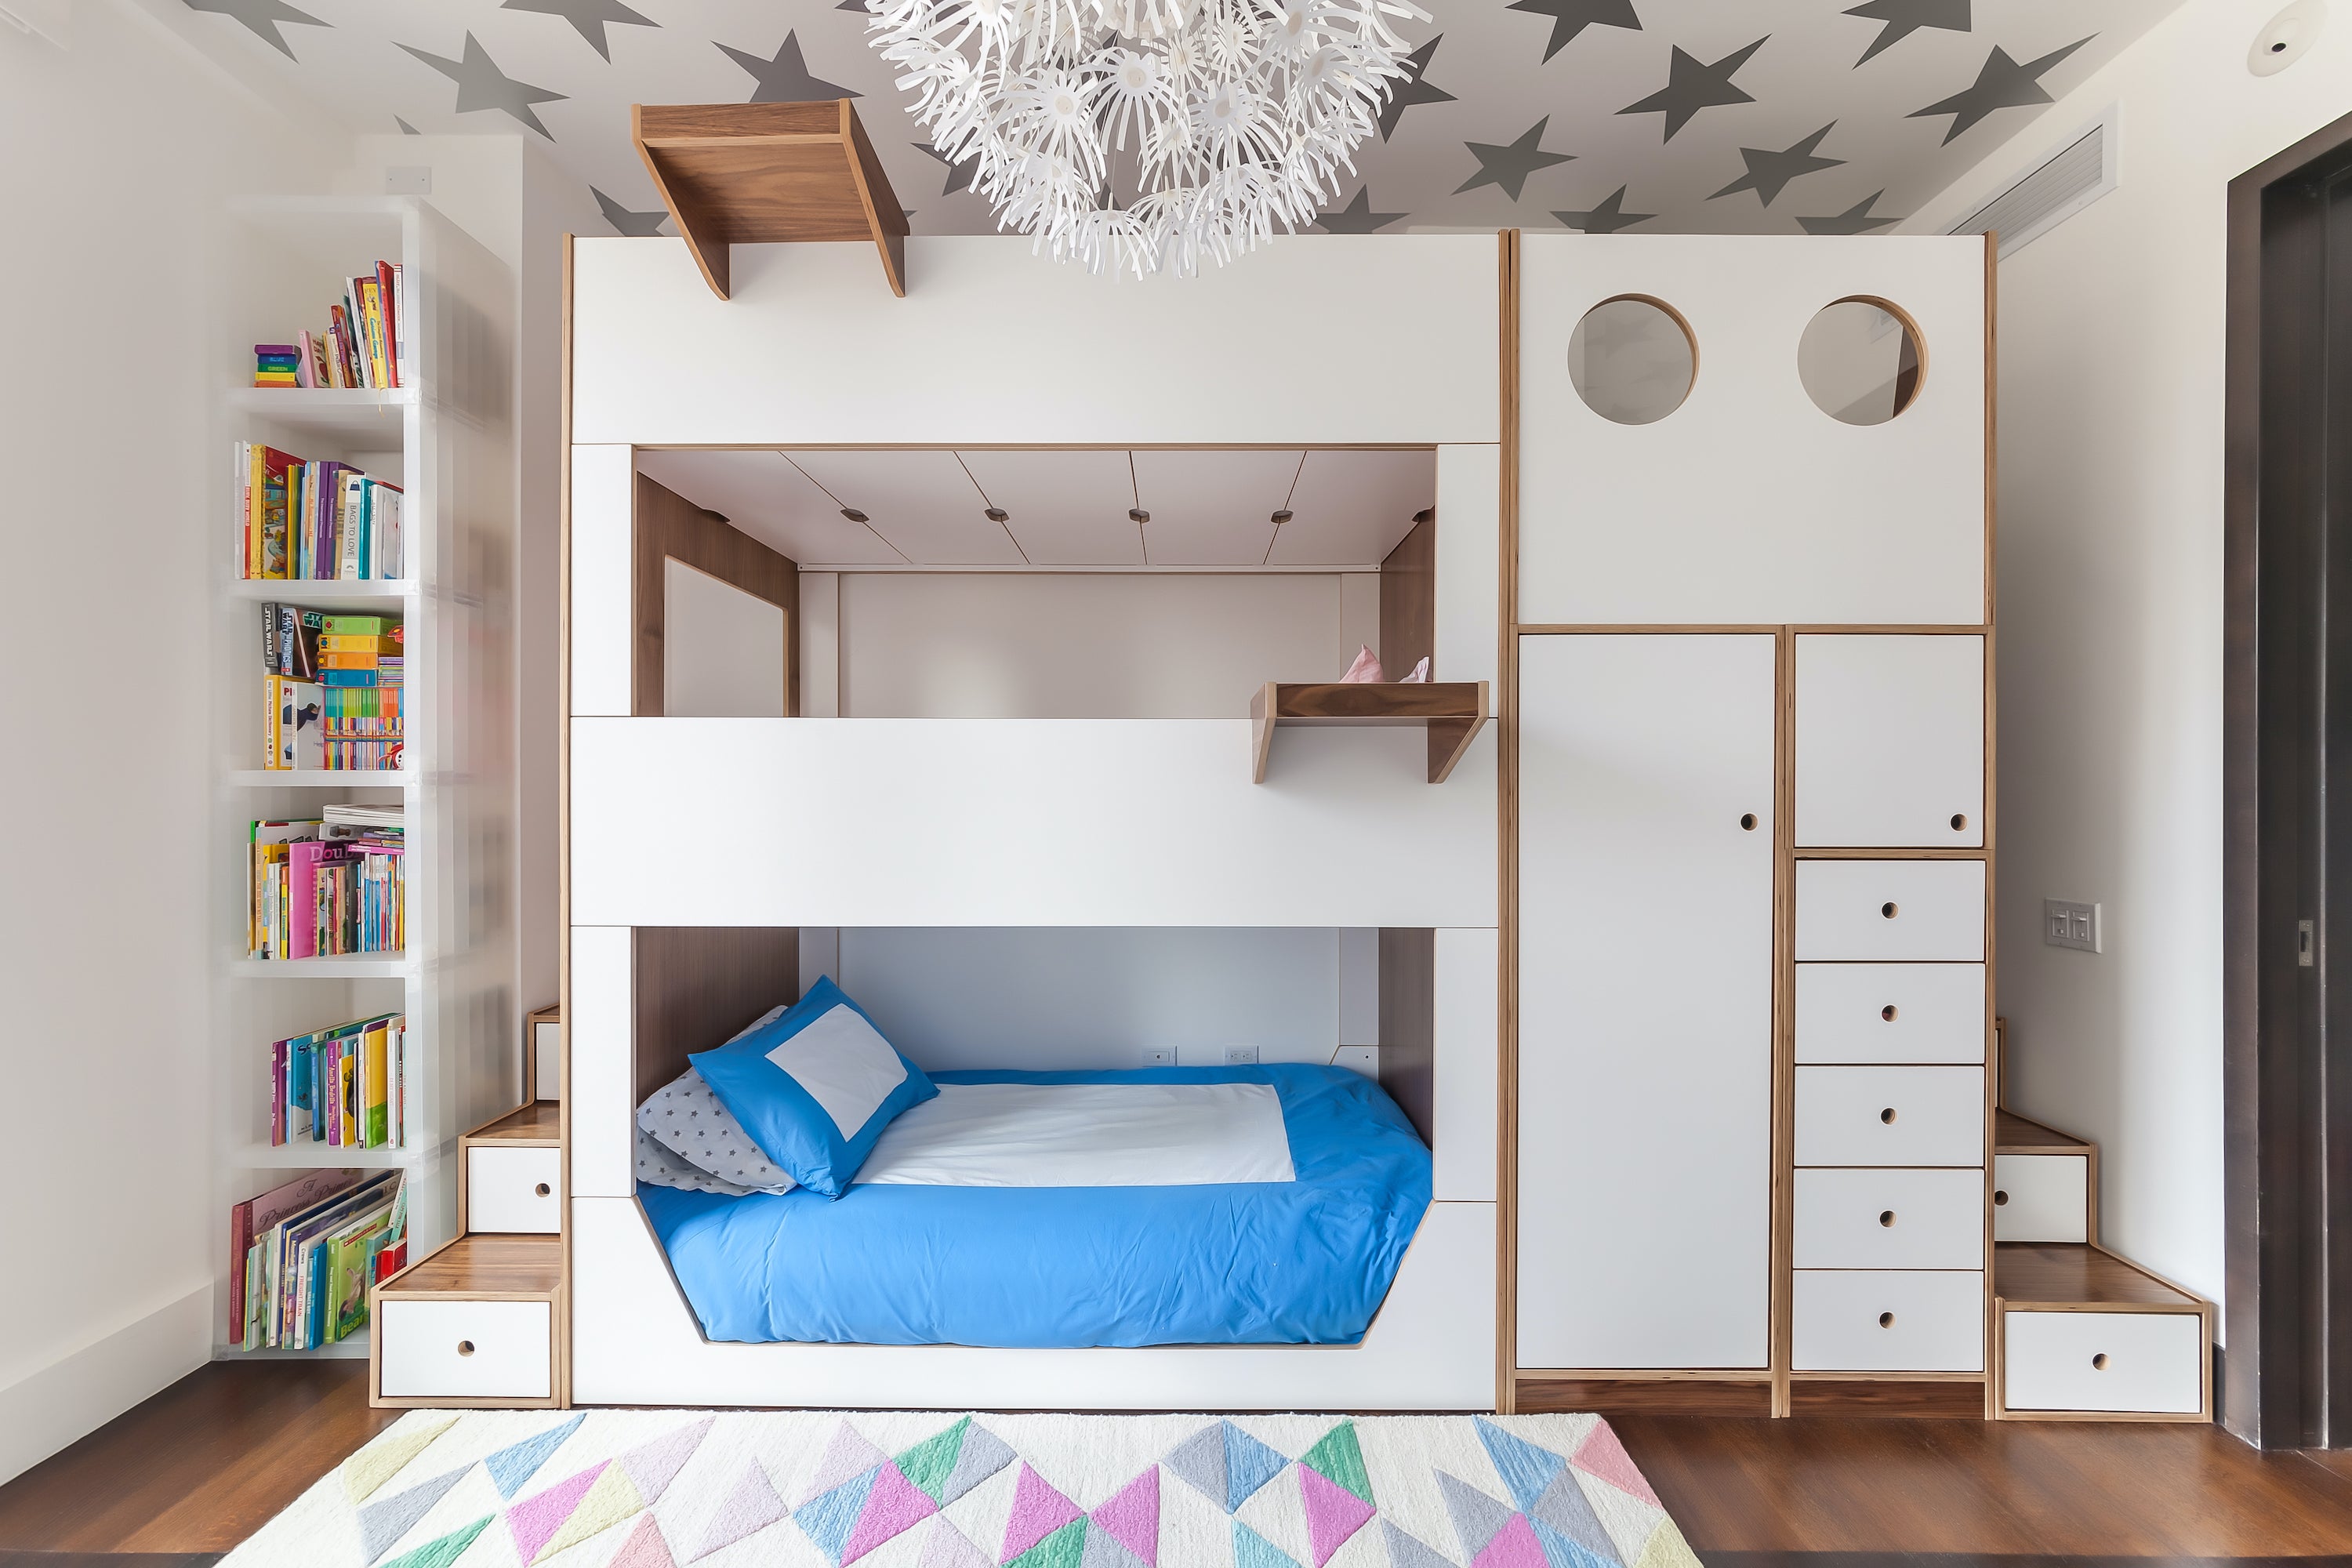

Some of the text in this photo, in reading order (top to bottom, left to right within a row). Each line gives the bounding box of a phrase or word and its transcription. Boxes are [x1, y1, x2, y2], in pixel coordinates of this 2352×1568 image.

[348, 525, 356, 536] TO
[347, 538, 355, 557] LOVE
[283, 638, 292, 663] PHONICS
[258, 1197, 310, 1230] Princess
[340, 1315, 365, 1338] Bear
